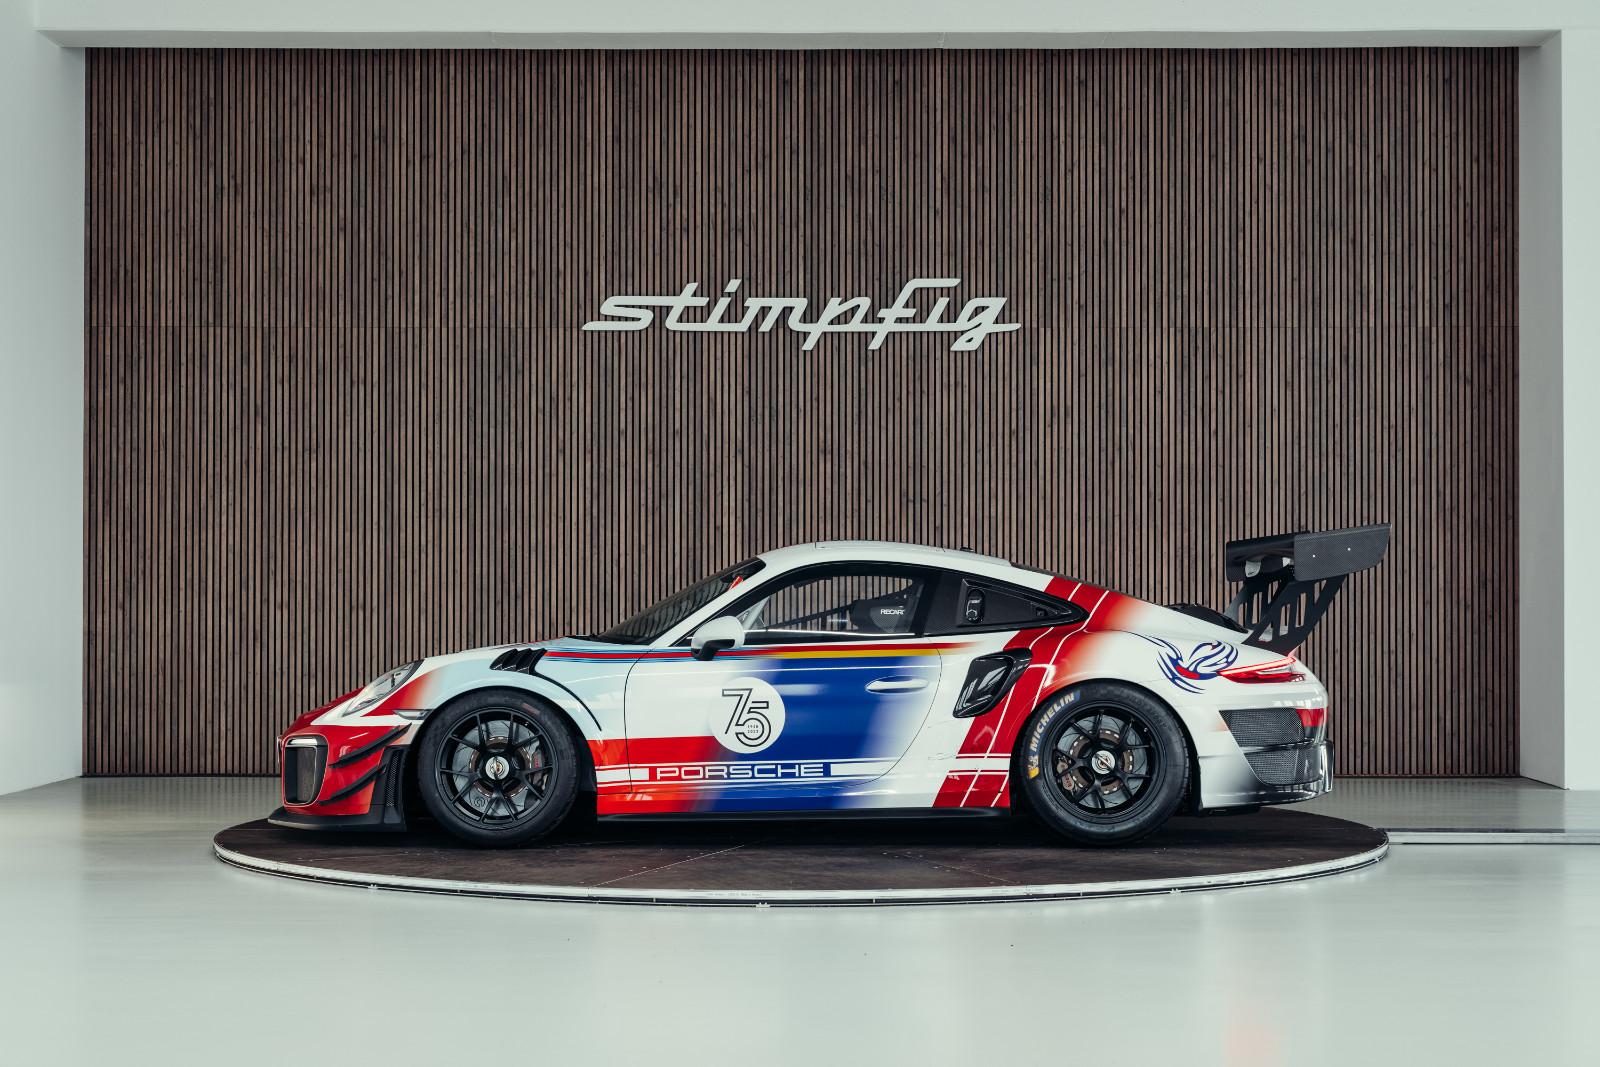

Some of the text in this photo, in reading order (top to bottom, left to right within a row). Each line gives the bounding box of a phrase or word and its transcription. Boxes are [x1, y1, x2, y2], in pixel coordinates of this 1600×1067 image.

[581, 278, 1022, 351] stimpfig
[721, 687, 771, 748] 75
[1029, 692, 1075, 752] MICHELIN
[656, 763, 824, 780] PORSCHE
